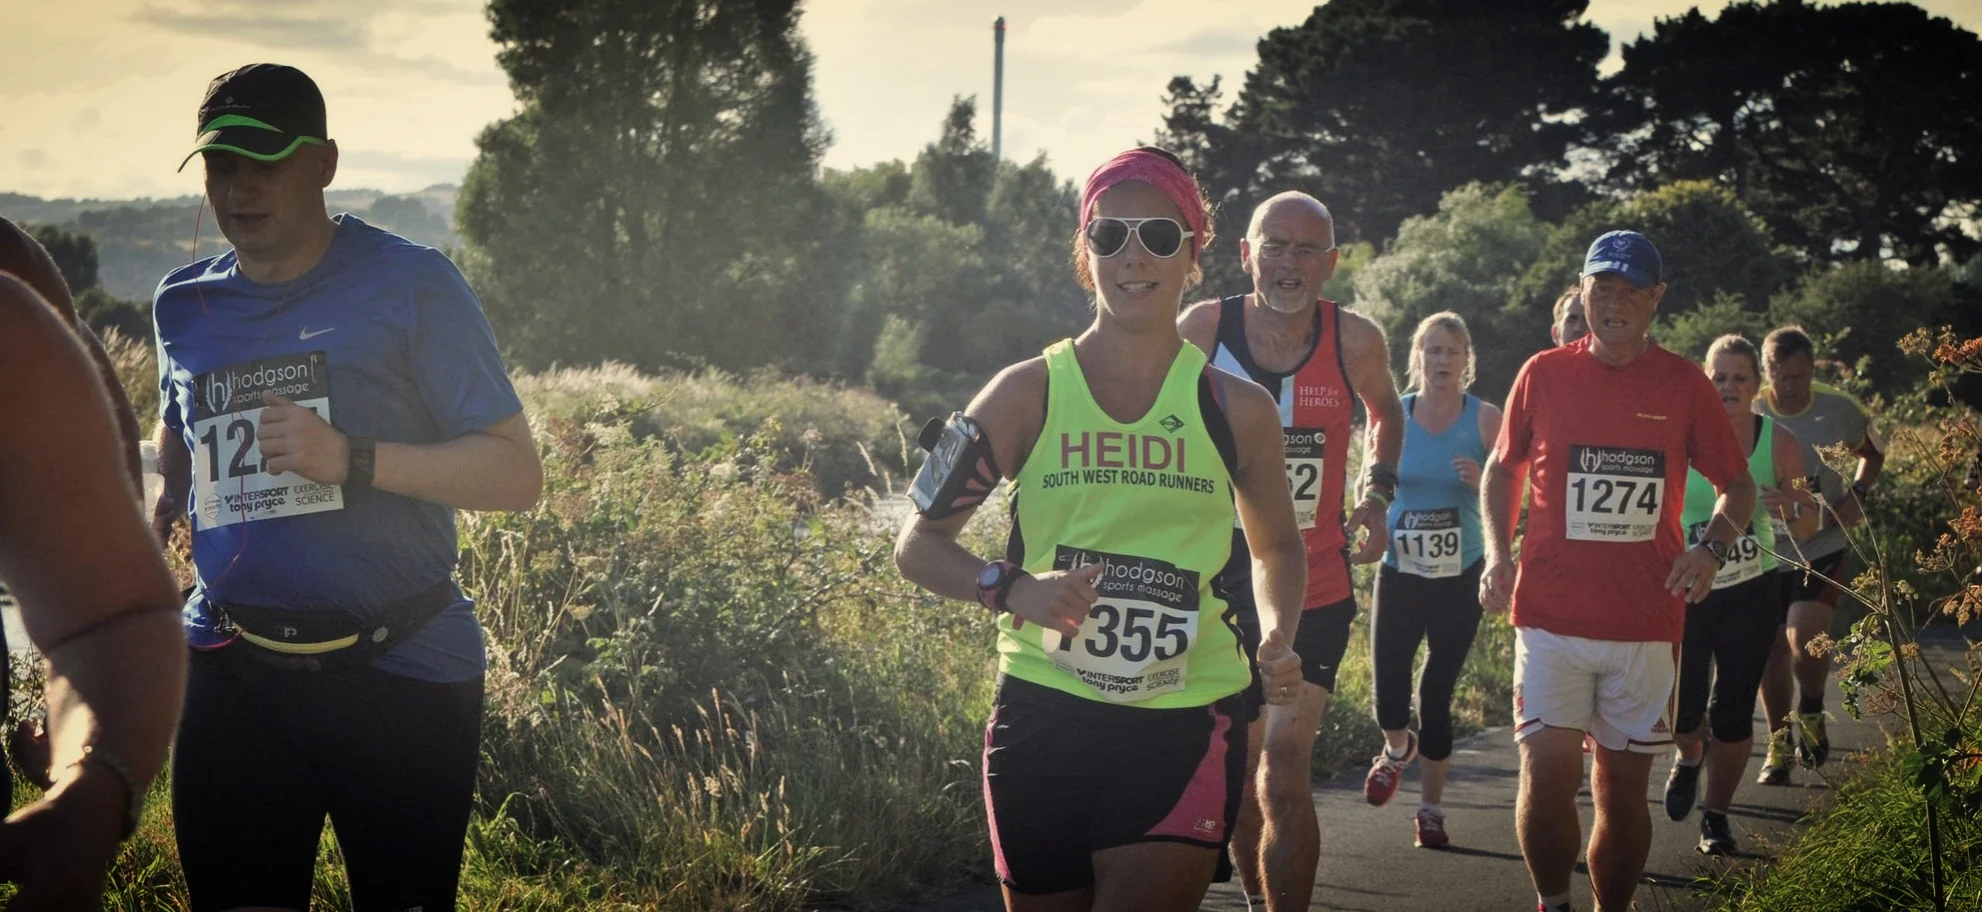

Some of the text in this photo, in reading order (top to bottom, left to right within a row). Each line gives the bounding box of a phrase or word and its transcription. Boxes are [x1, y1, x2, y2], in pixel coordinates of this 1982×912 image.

[232, 365, 308, 389] hodgson
[233, 383, 309, 404] ports assage
[1300, 386, 1326, 396] HELP
[1300, 397, 1340, 407] HEROES
[1061, 432, 1185, 473] HEIDI
[1602, 450, 1655, 466] hodgson
[1042, 470, 1215, 494] SOUTH WEST ROAD RUNNERS
[234, 486, 289, 503] INTERSPORT
[295, 493, 335, 506] SCIENCE
[1571, 478, 1658, 515] 1274
[230, 497, 286, 513] tony pryce
[1397, 532, 1458, 558] 1139
[1105, 558, 1184, 589] hodgson
[1103, 581, 1183, 602] sports massage
[1082, 677, 1139, 694] tony pryce
[1087, 671, 1144, 685] INTERSPORT
